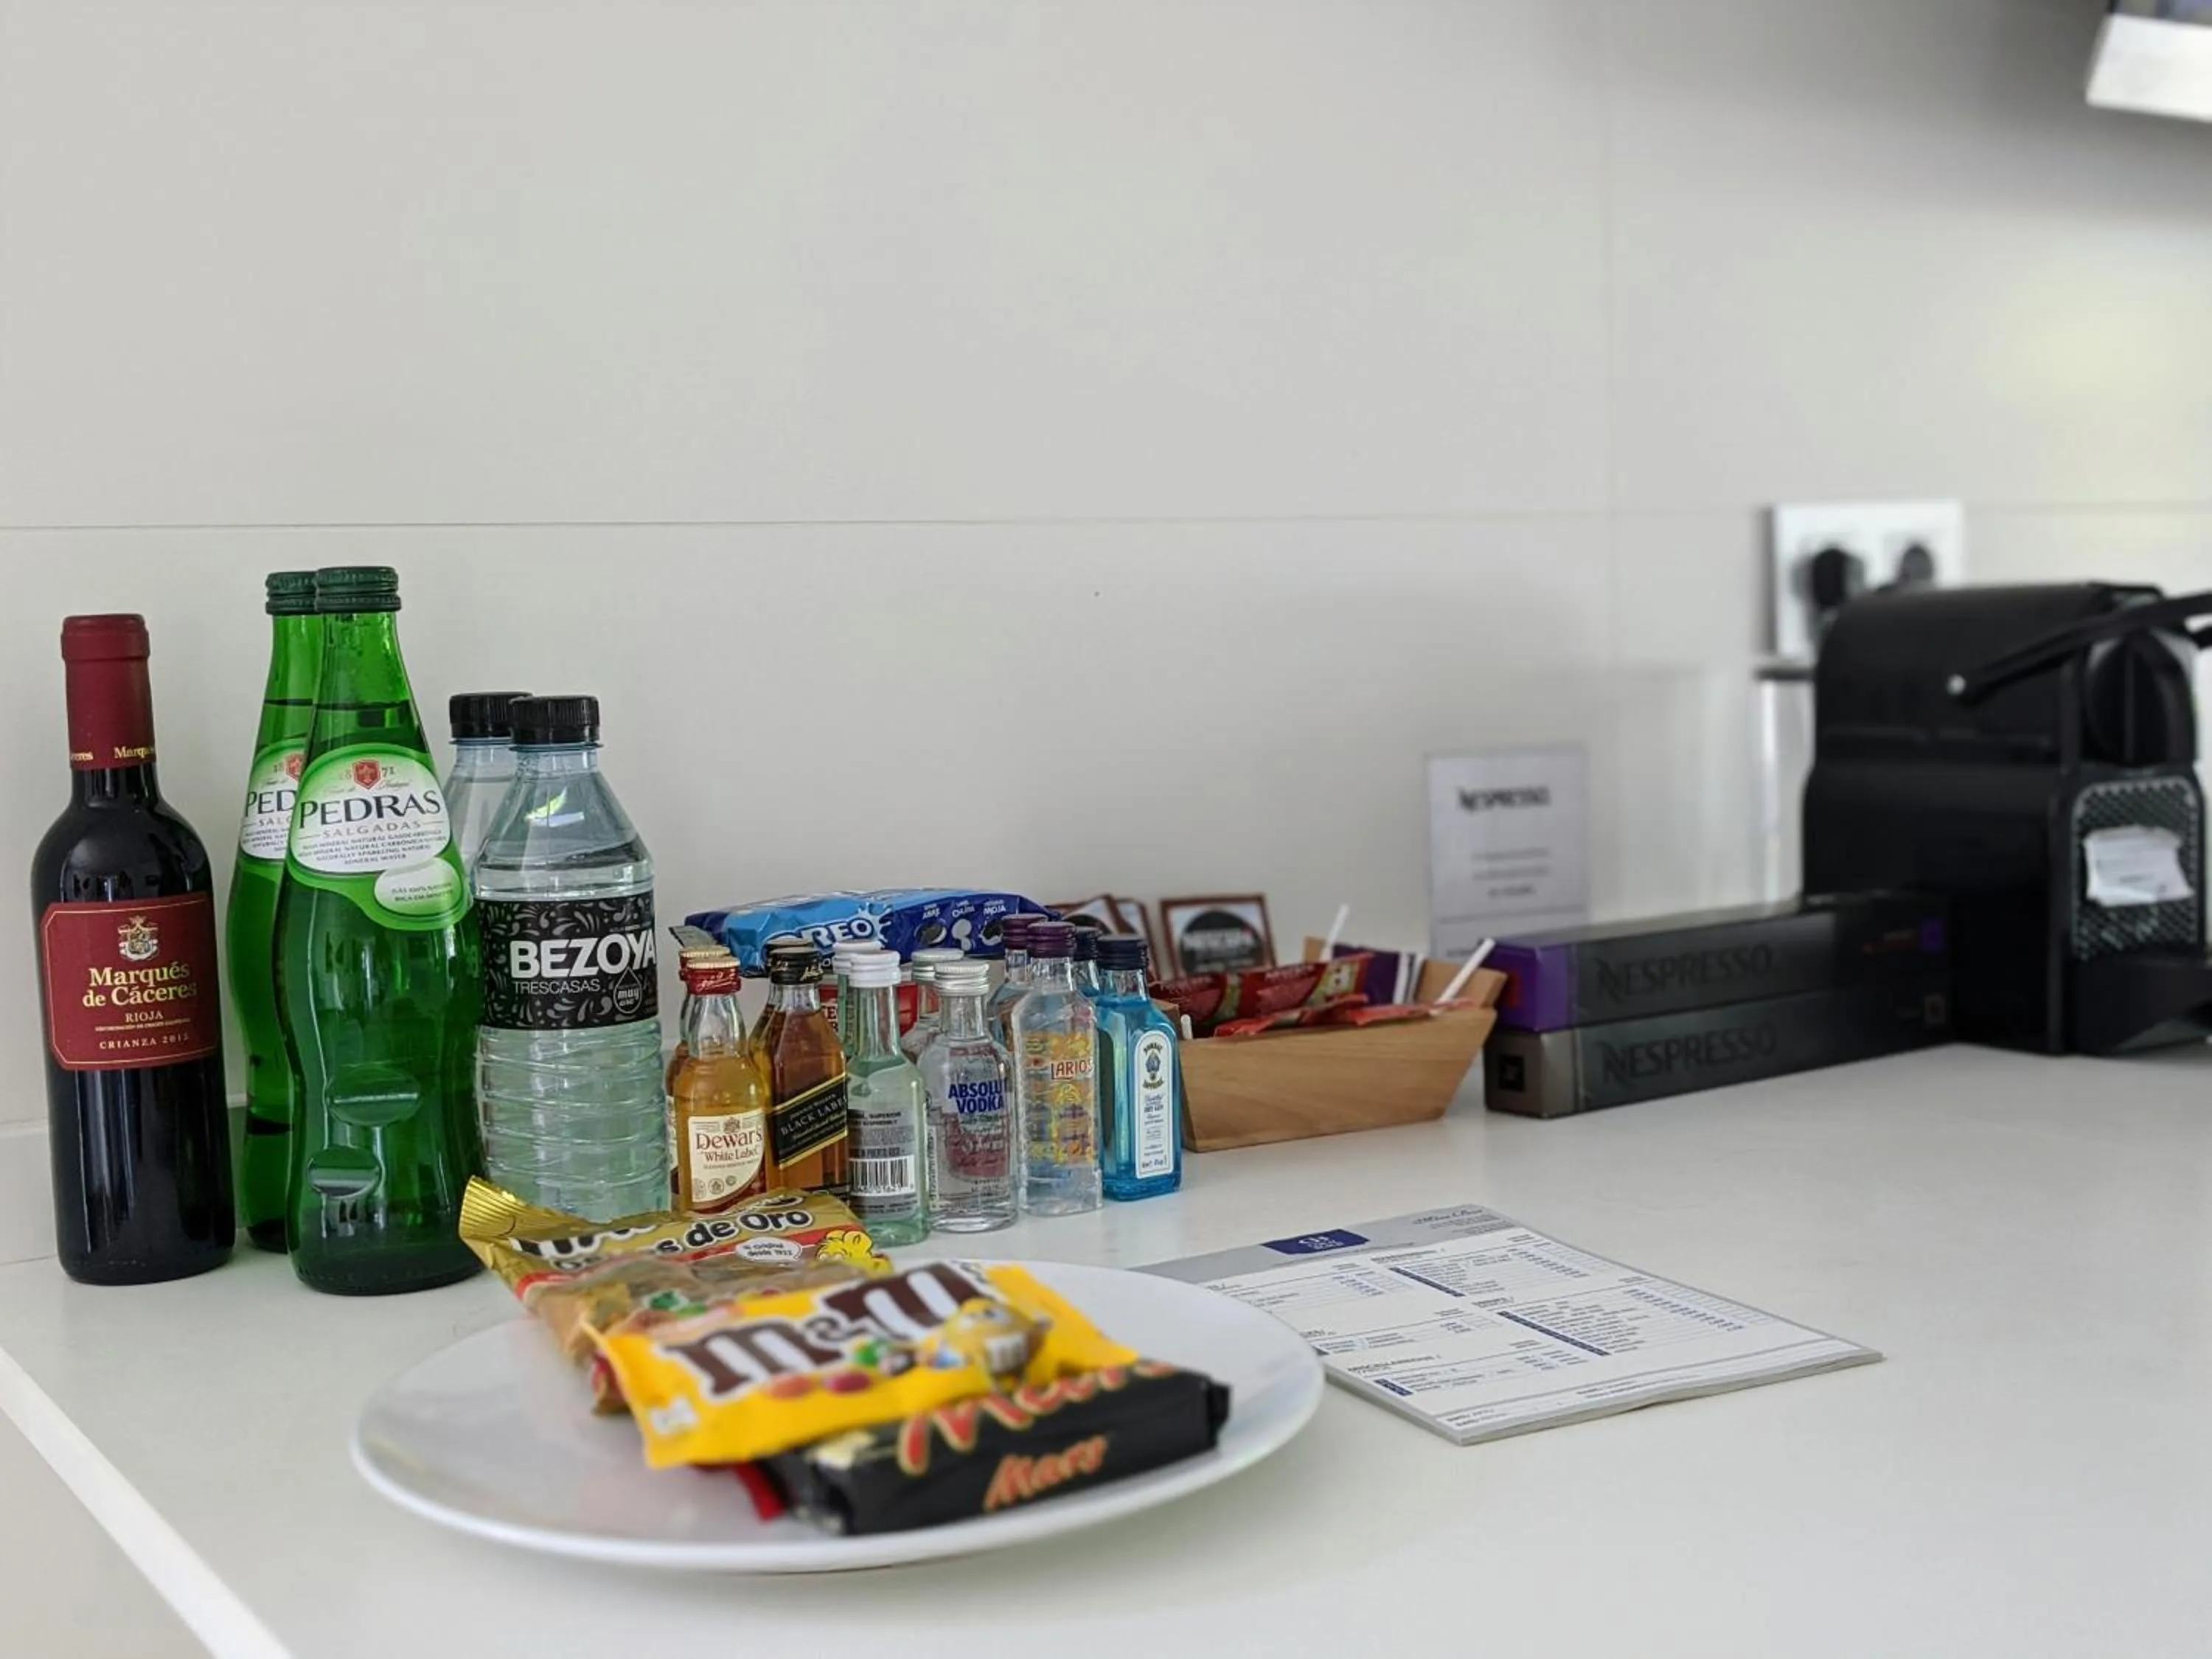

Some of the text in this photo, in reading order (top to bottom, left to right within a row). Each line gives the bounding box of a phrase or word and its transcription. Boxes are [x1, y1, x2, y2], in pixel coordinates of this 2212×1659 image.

[299, 789, 441, 830] PEDRAS
[323, 820, 421, 838] SALGADAS
[773, 918, 874, 949] REO
[509, 928, 656, 978] BEZOYA
[88, 961, 190, 987] Marqués
[513, 978, 601, 995] TRESCASAS
[1597, 945, 1773, 1002] NESPRESSO
[83, 982, 198, 1007] de Cáceres
[125, 1010, 164, 1023] RIOJA
[100, 1037, 157, 1049] CRIANZA
[1599, 1020, 1777, 1086] NESPRESSO
[956, 1095, 1004, 1114] VODKA
[686, 1221, 735, 1245] de
[740, 1210, 811, 1231] Oro
[984, 1435, 1107, 1512] Mars
